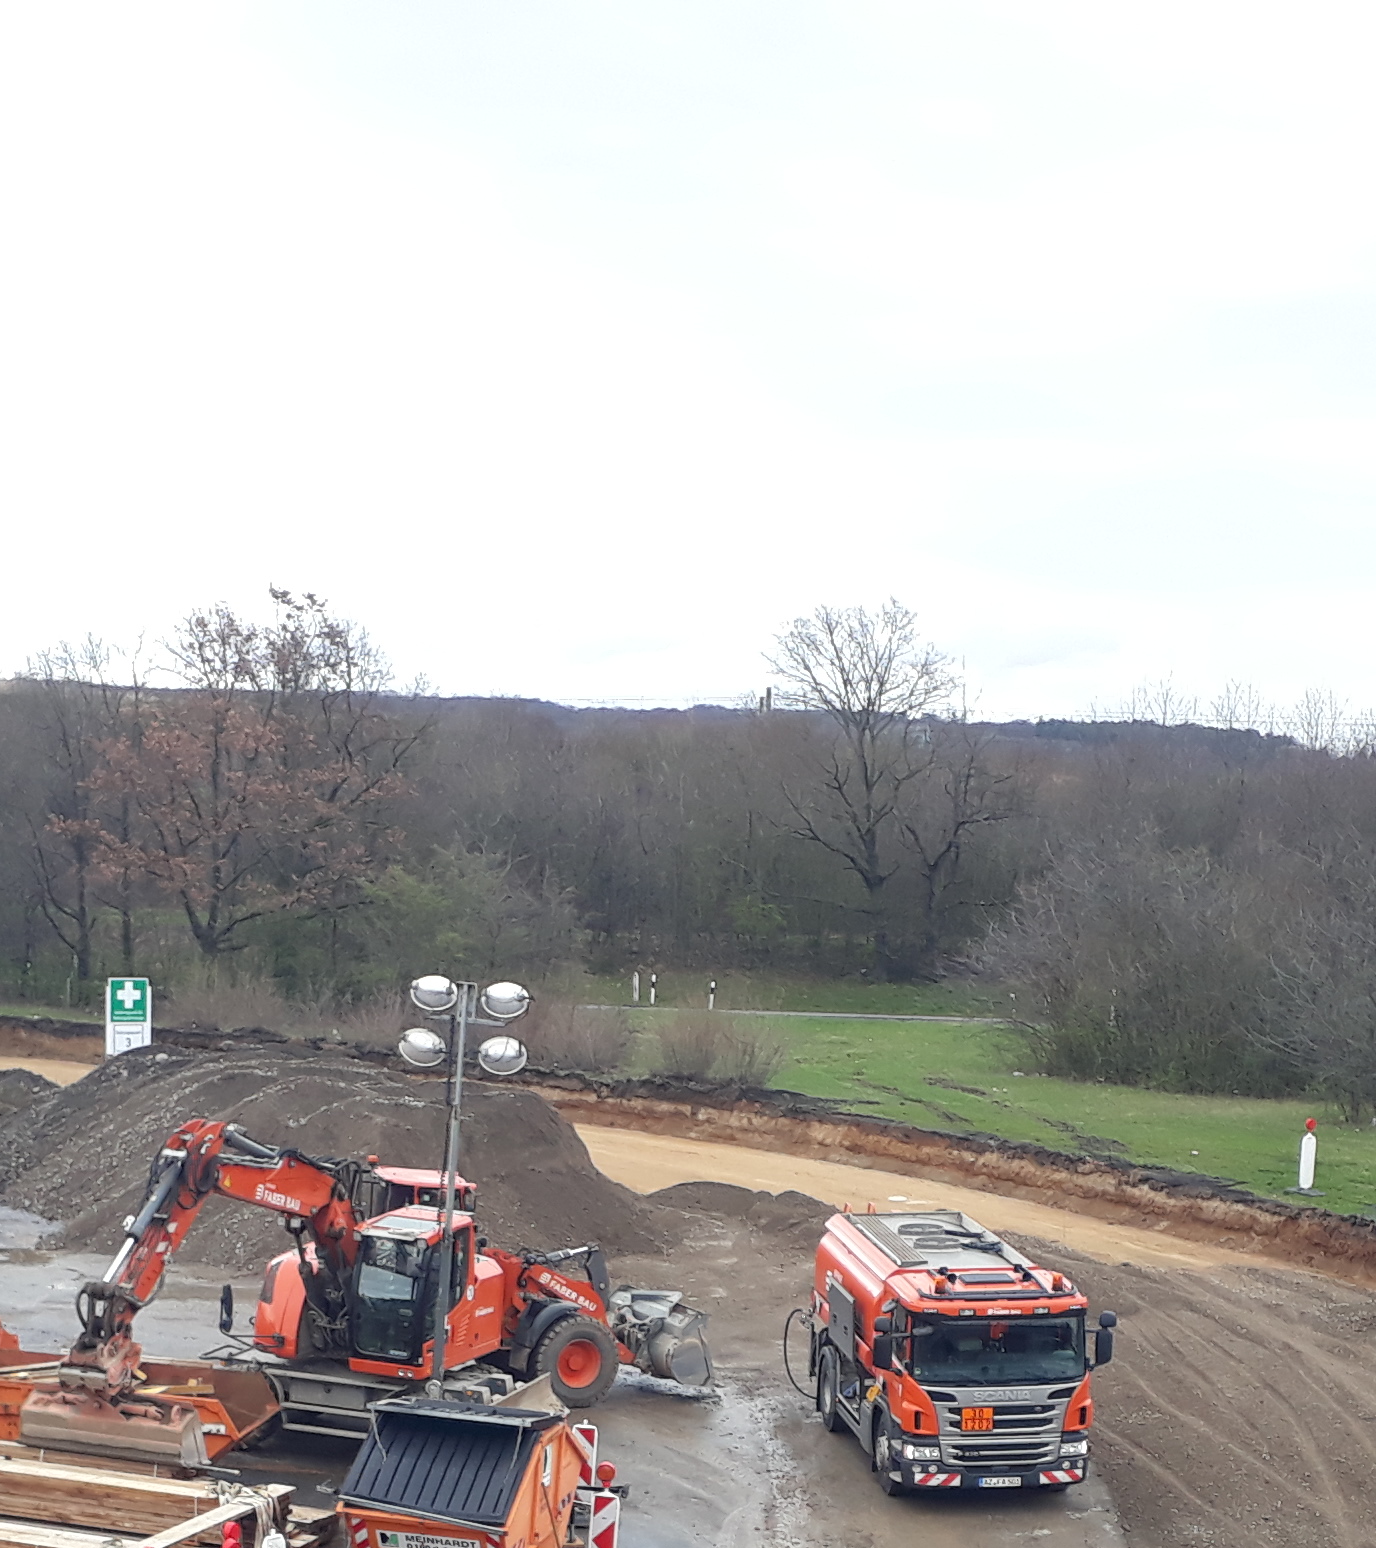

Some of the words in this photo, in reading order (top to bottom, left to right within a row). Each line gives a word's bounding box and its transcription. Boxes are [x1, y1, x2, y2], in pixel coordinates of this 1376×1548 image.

[549, 1280, 578, 1301] FABER
[577, 1295, 597, 1312] BAU
[973, 1390, 1031, 1402] SCANIA
[971, 1408, 984, 1418] 30
[964, 1420, 991, 1430] 1202
[405, 1534, 477, 1548] MEINHARDT
